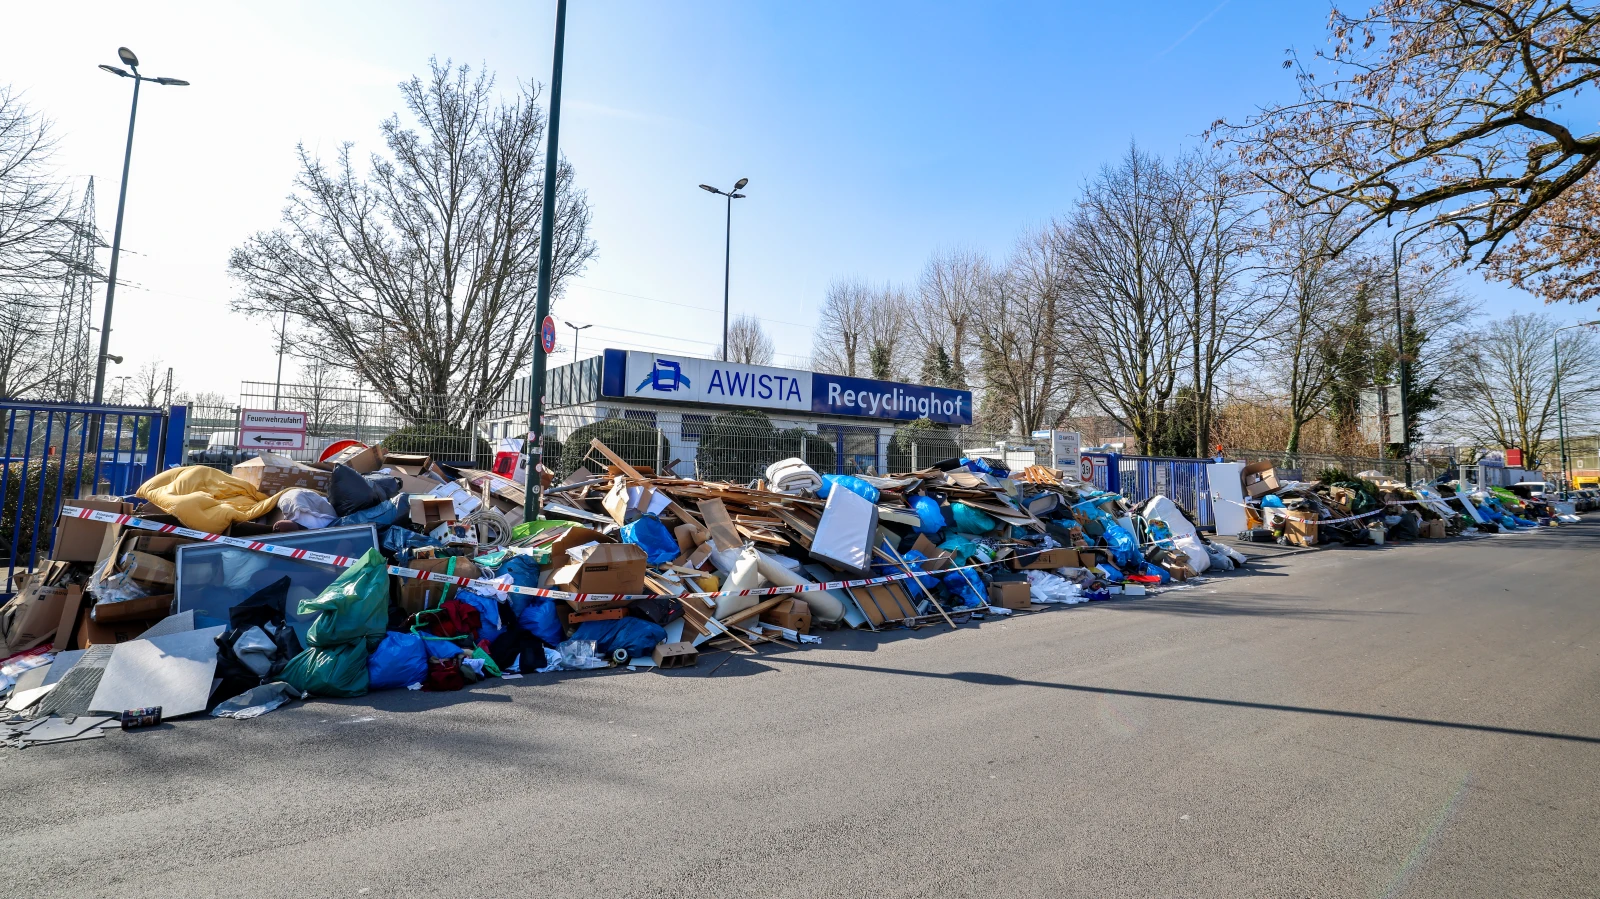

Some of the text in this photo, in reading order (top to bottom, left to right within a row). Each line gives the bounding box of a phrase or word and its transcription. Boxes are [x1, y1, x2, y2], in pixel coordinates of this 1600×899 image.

[707, 369, 802, 402] AWISTA
[828, 382, 962, 418] Recyclinghof
[247, 414, 302, 424] Feuerwehrzufahrt
